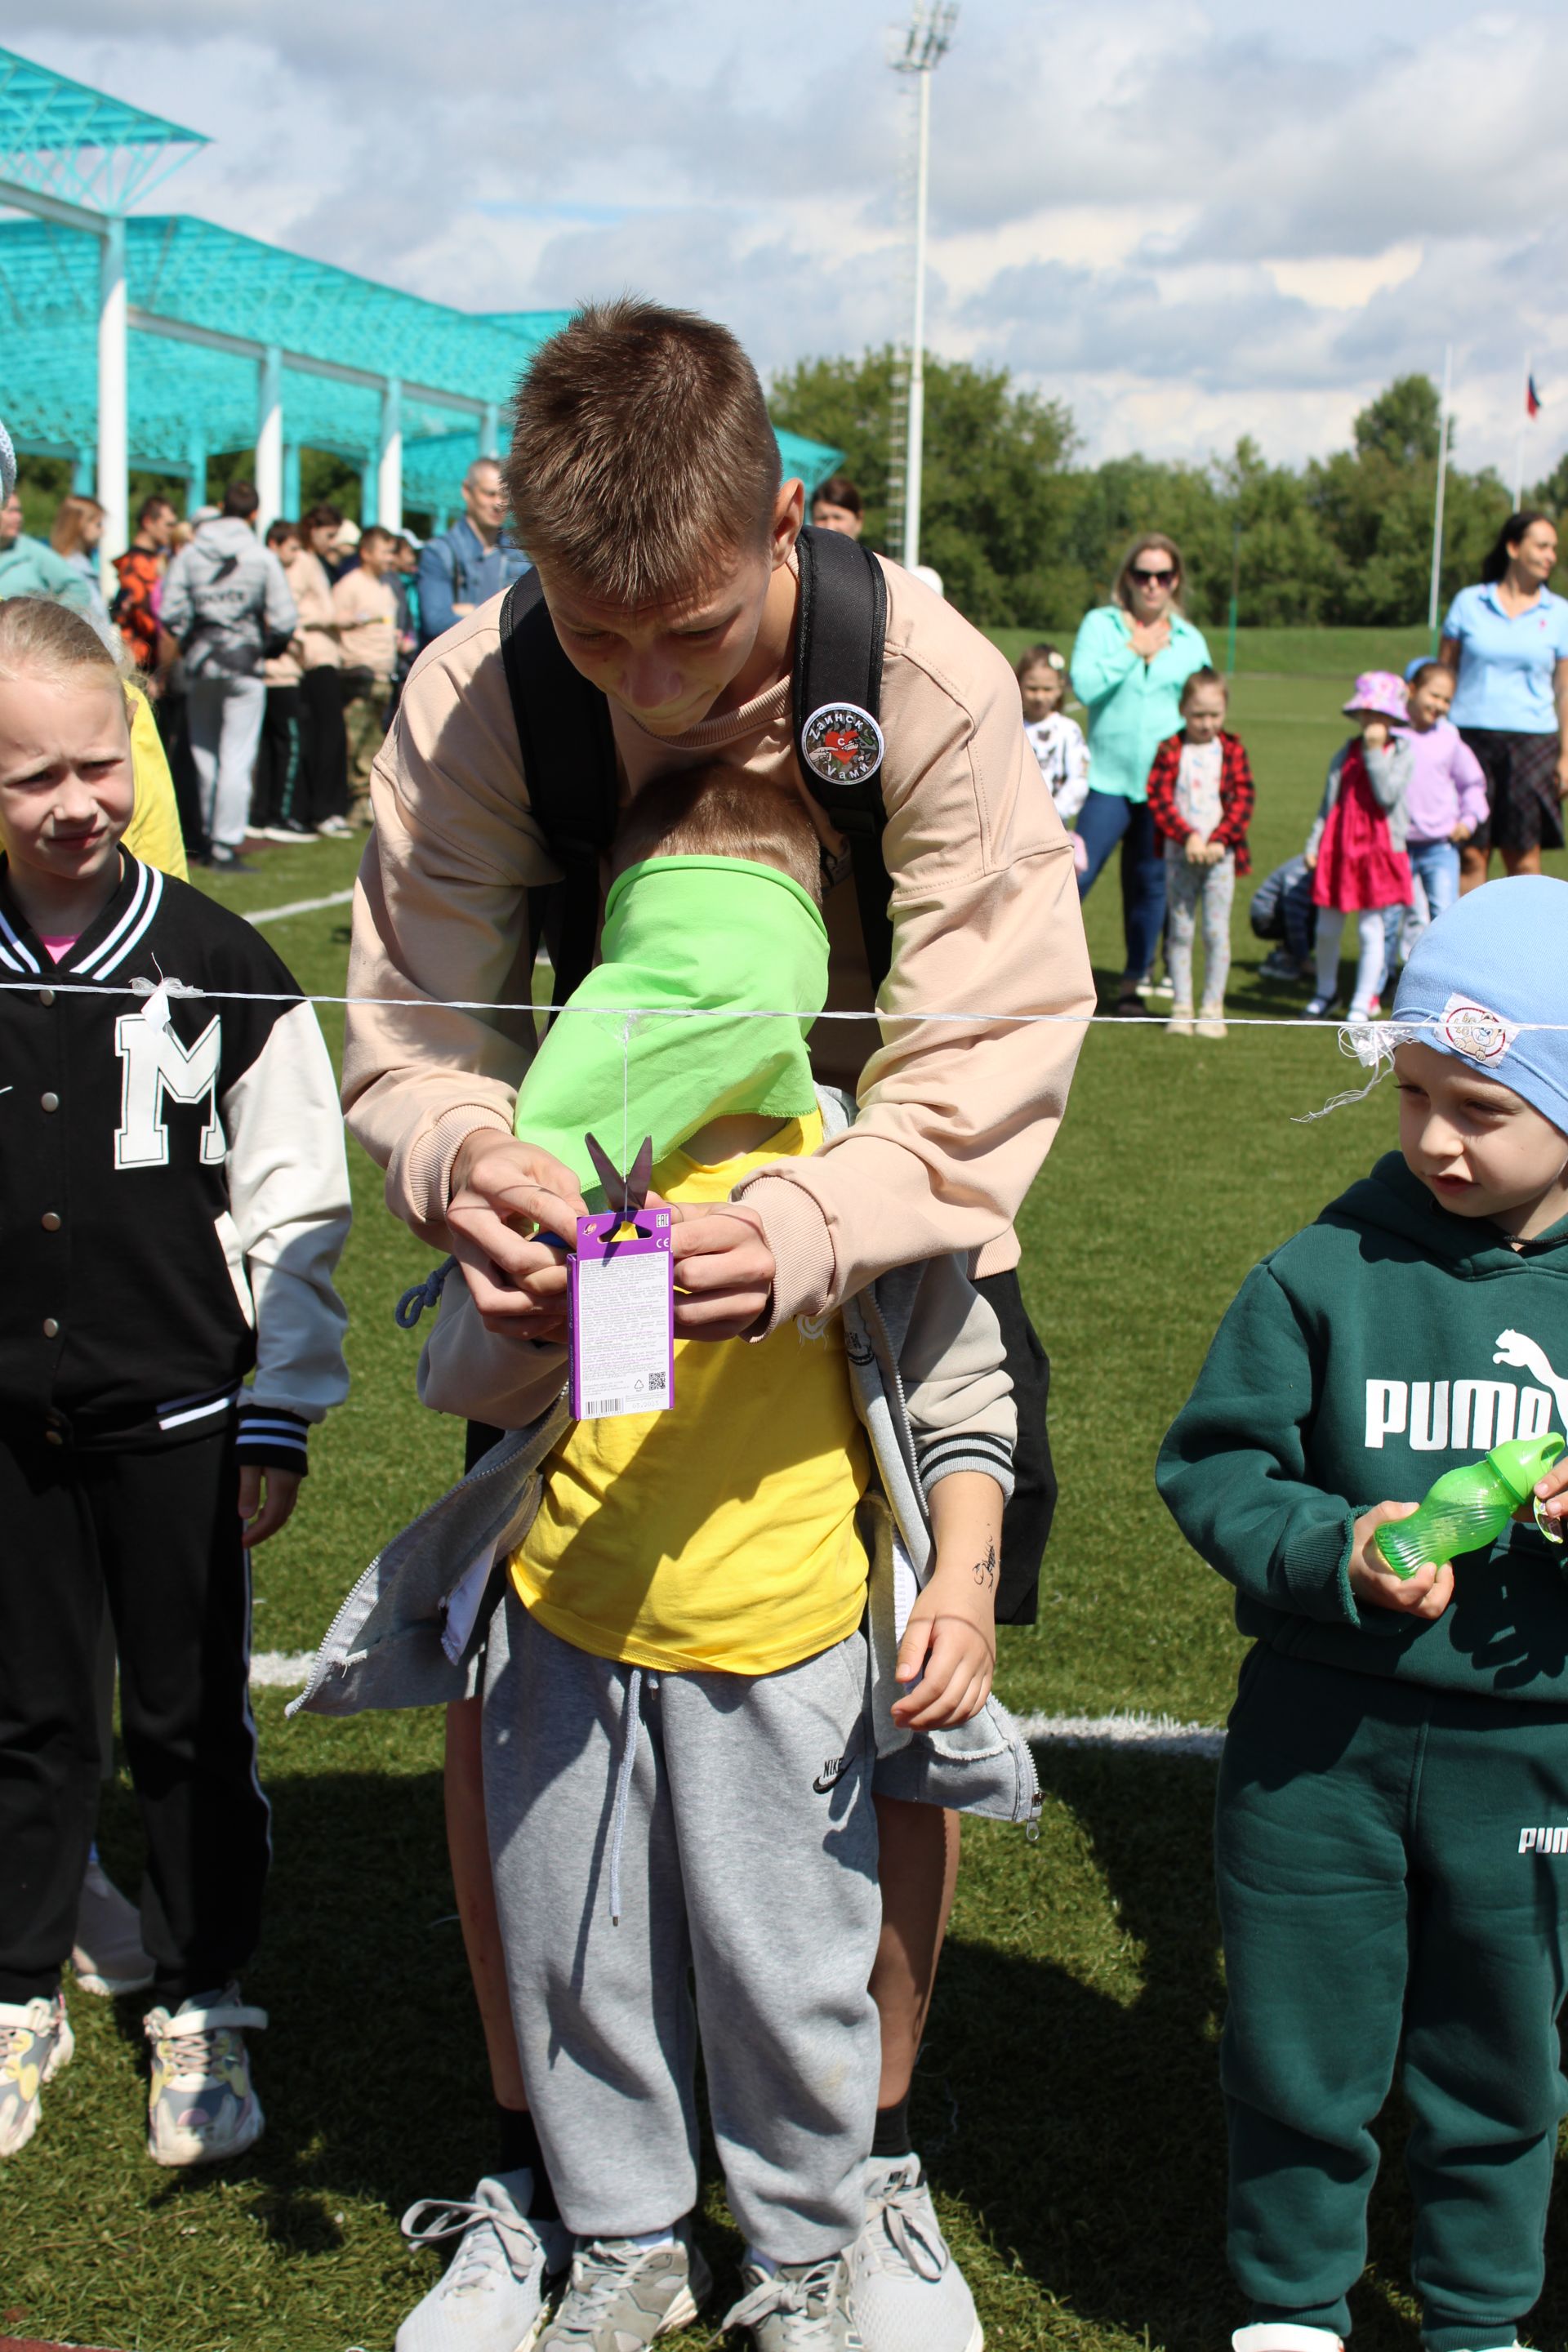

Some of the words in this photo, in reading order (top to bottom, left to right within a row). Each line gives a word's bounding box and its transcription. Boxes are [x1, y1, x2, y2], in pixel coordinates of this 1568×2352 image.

[114, 1013, 227, 1170] M
[1365, 1379, 1552, 1451] PUMA
[823, 1757, 844, 1779] NIKE
